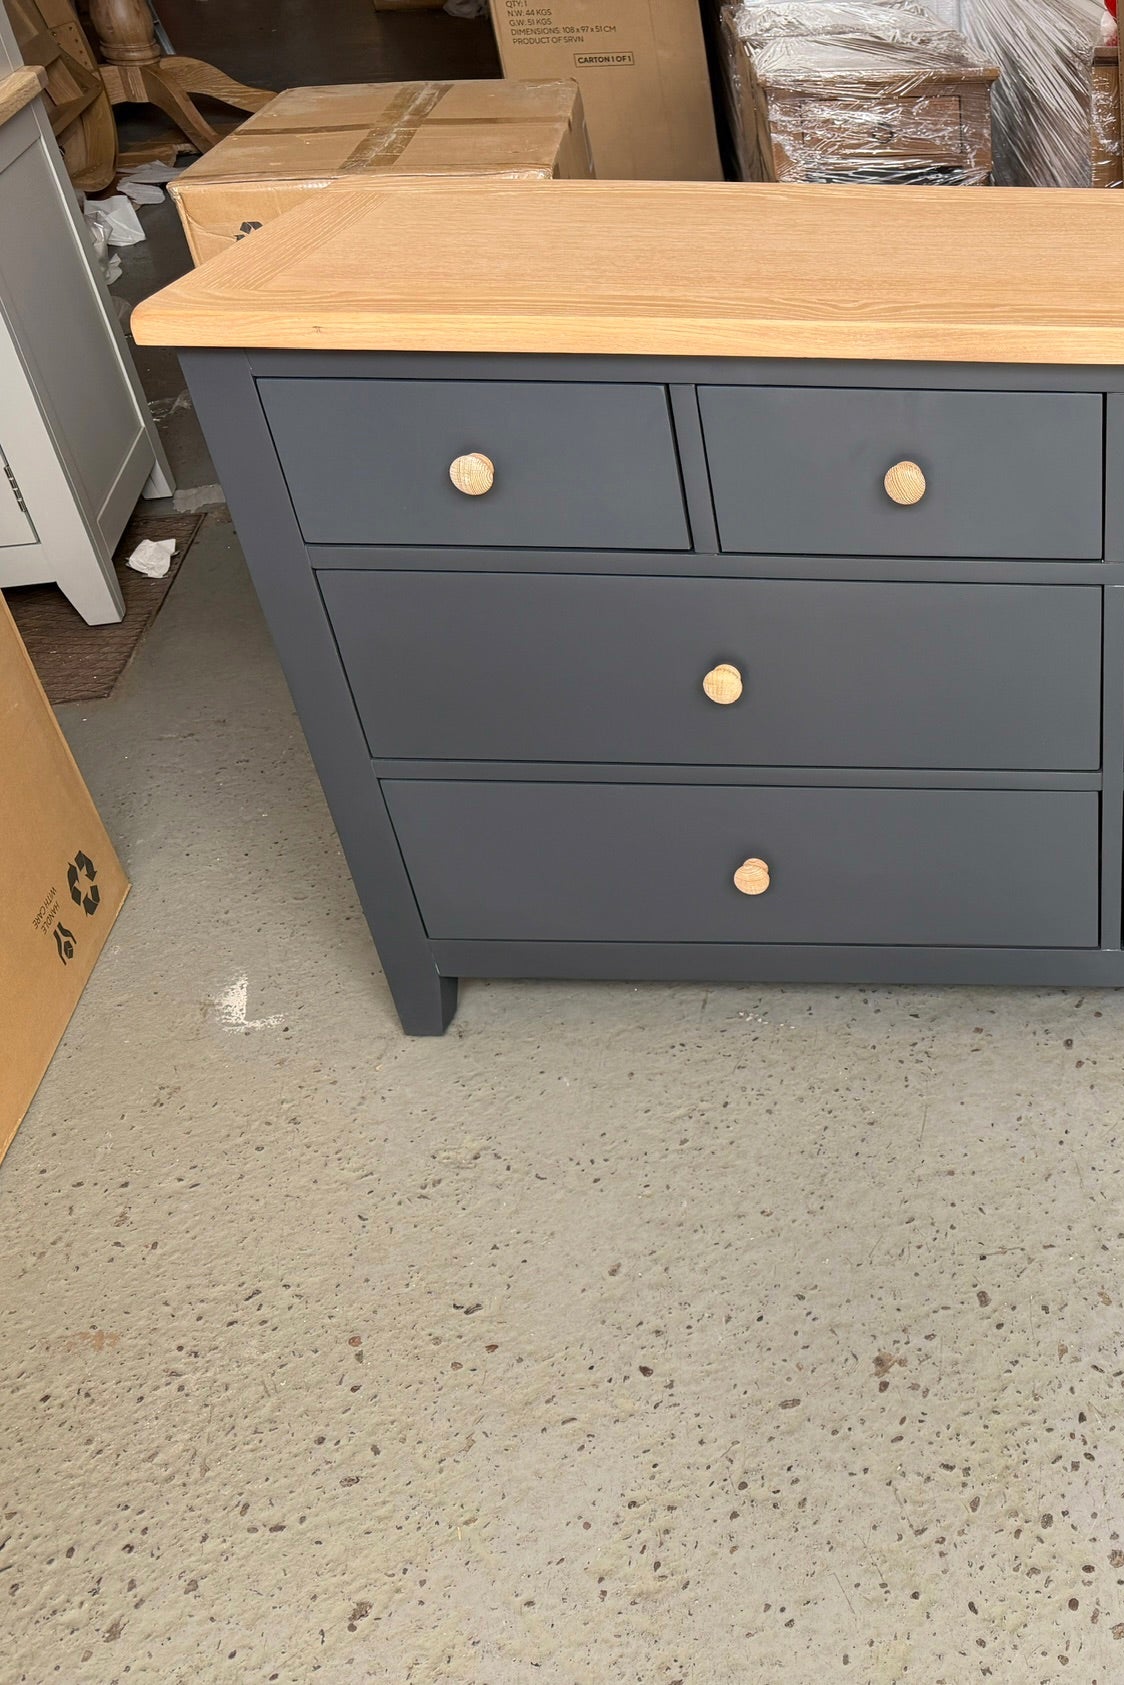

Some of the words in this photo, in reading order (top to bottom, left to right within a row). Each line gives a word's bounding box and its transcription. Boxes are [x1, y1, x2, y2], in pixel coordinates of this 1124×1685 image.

[536, 8, 552, 16] KGS
[536, 18, 552, 26] KGS
[511, 27, 560, 36] DIMENSIONS:
[512, 36, 551, 45] PRODUCT
[551, 36, 563, 44] OF
[577, 56, 610, 64] CARTON
[44, 886, 57, 908] WITH
[32, 906, 46, 929] CARE
[40, 901, 60, 935] HANDLE
